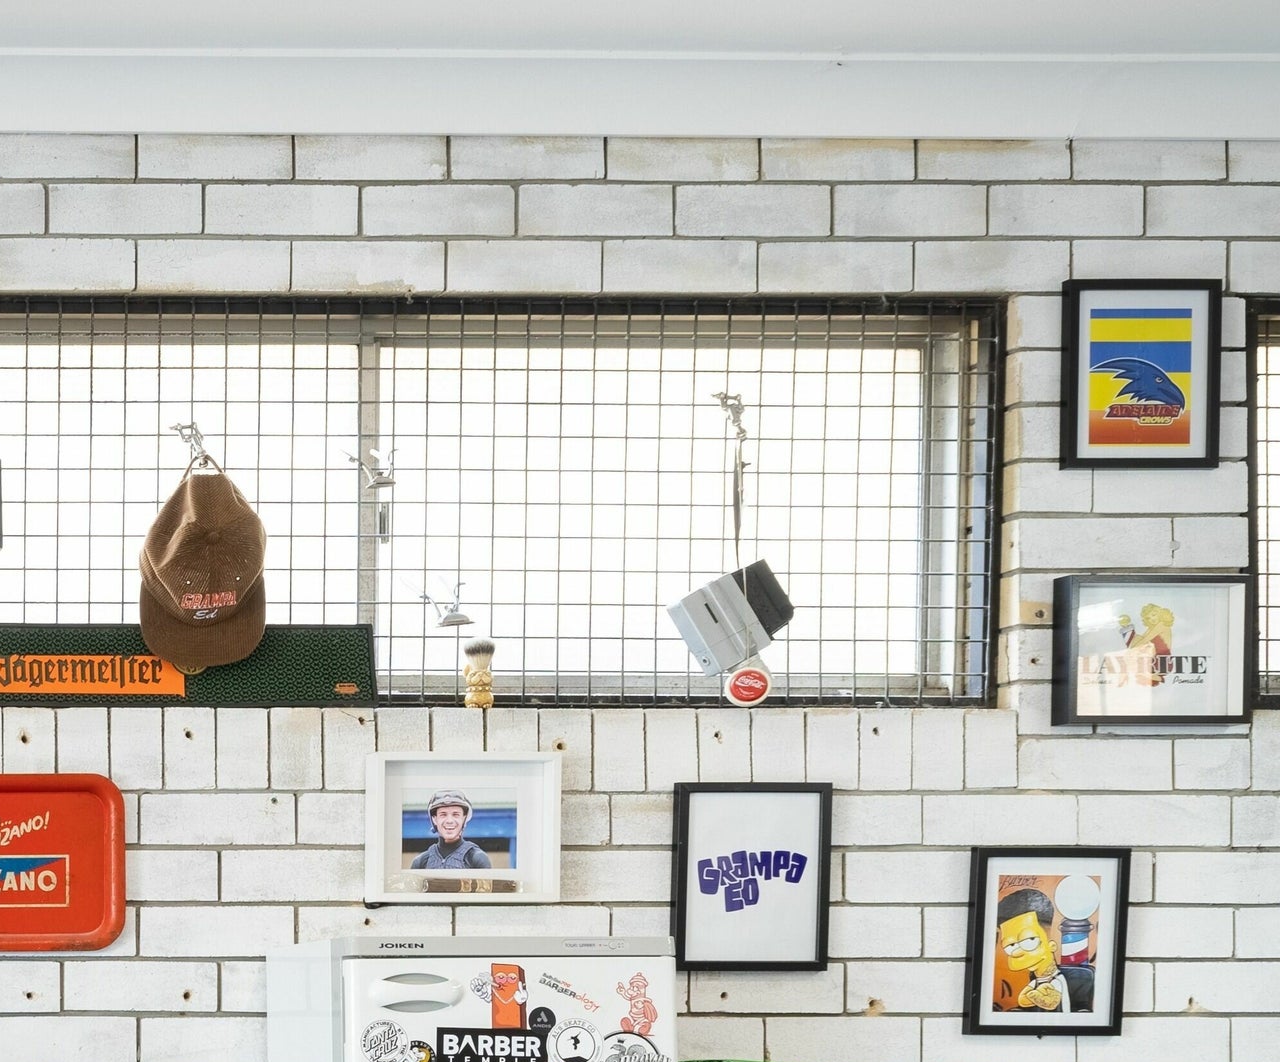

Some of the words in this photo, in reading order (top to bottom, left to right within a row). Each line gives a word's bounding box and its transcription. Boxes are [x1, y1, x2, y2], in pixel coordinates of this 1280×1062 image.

[1113, 404, 1181, 416] ADELAIDE
[1139, 416, 1172, 424] CROWS
[193, 609, 218, 620] Ed
[723, 877, 760, 912] ED
[443, 1034, 541, 1057] BARBER
